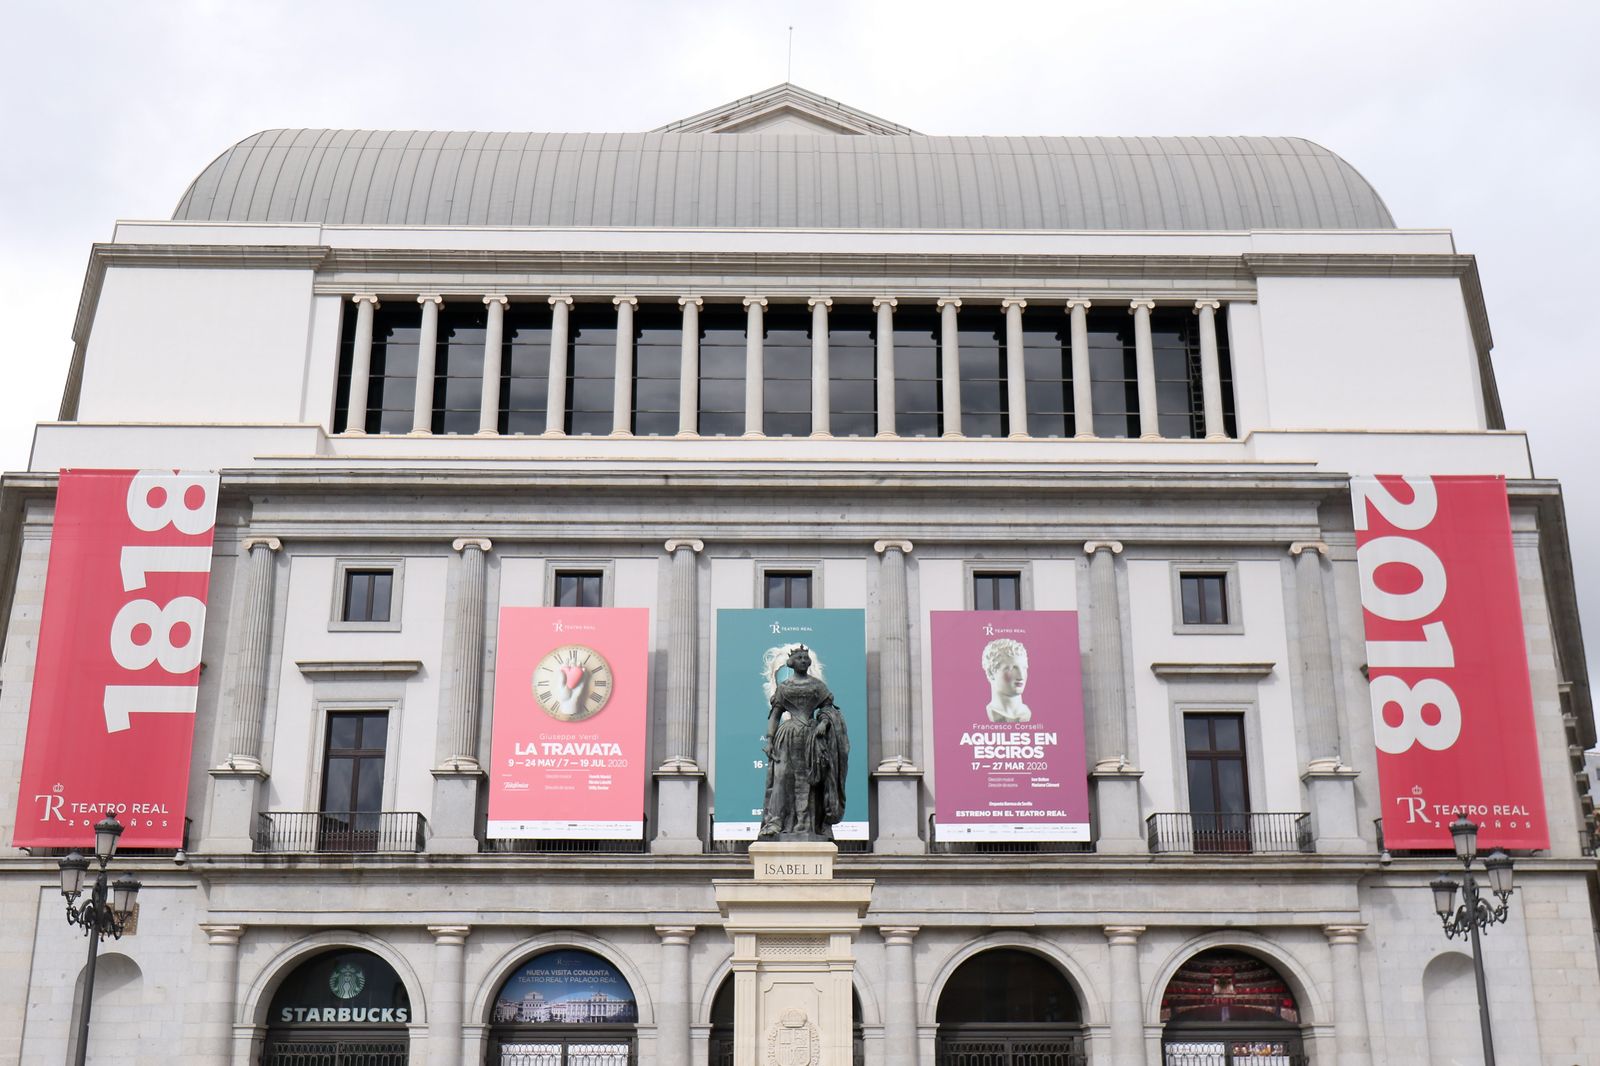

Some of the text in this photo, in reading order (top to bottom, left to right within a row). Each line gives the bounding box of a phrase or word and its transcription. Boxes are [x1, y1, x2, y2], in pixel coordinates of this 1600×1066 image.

[103, 469, 220, 733] 1818
[1350, 475, 1461, 754] 2018
[539, 733, 600, 741] Giuseppe Verdi
[960, 732, 1058, 746] AQUILES EN
[515, 742, 623, 756] LA TRAVIATA
[974, 746, 1045, 759] ESCIROS
[508, 759, 515, 768] 9
[525, 759, 536, 767] 24
[537, 759, 555, 767] MAY
[564, 759, 570, 768] 7
[580, 759, 589, 767] 19
[590, 759, 606, 767] JUL
[607, 759, 628, 767] 2020
[753, 760, 763, 768] 16
[971, 762, 981, 770] 17
[992, 762, 1003, 770] 27
[1005, 762, 1025, 770] MAR
[1026, 762, 1048, 770] 2020
[71, 803, 169, 814] TEATRO REAL
[1433, 805, 1530, 816] TEATRO REAL
[1480, 821, 1531, 829] AÑOS
[764, 863, 823, 875] ISABEL II
[281, 1007, 408, 1022] STARBUCKS
